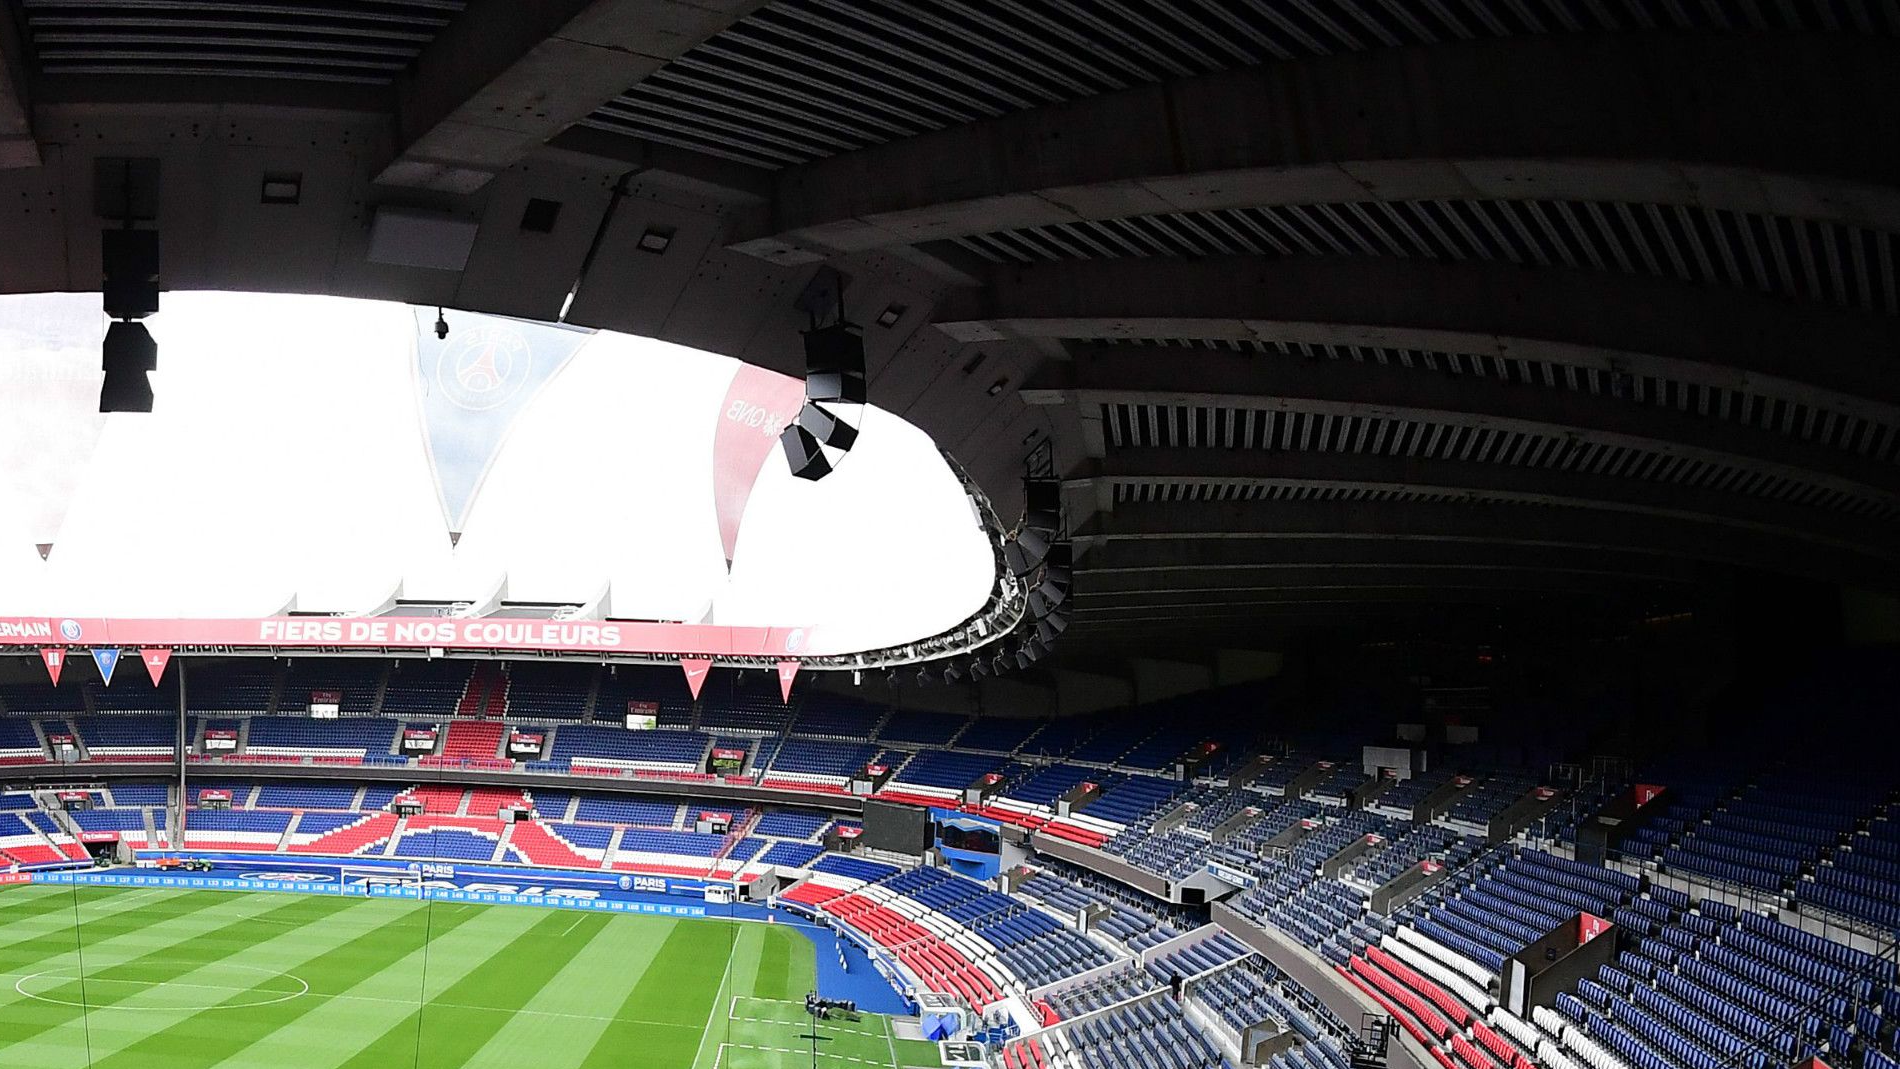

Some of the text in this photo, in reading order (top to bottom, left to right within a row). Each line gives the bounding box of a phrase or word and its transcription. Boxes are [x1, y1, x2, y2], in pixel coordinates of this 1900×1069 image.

[260, 621, 622, 646] FIERS DE NOS COULEURS
[423, 865, 454, 874] PARIS
[634, 877, 666, 888] PARIS
